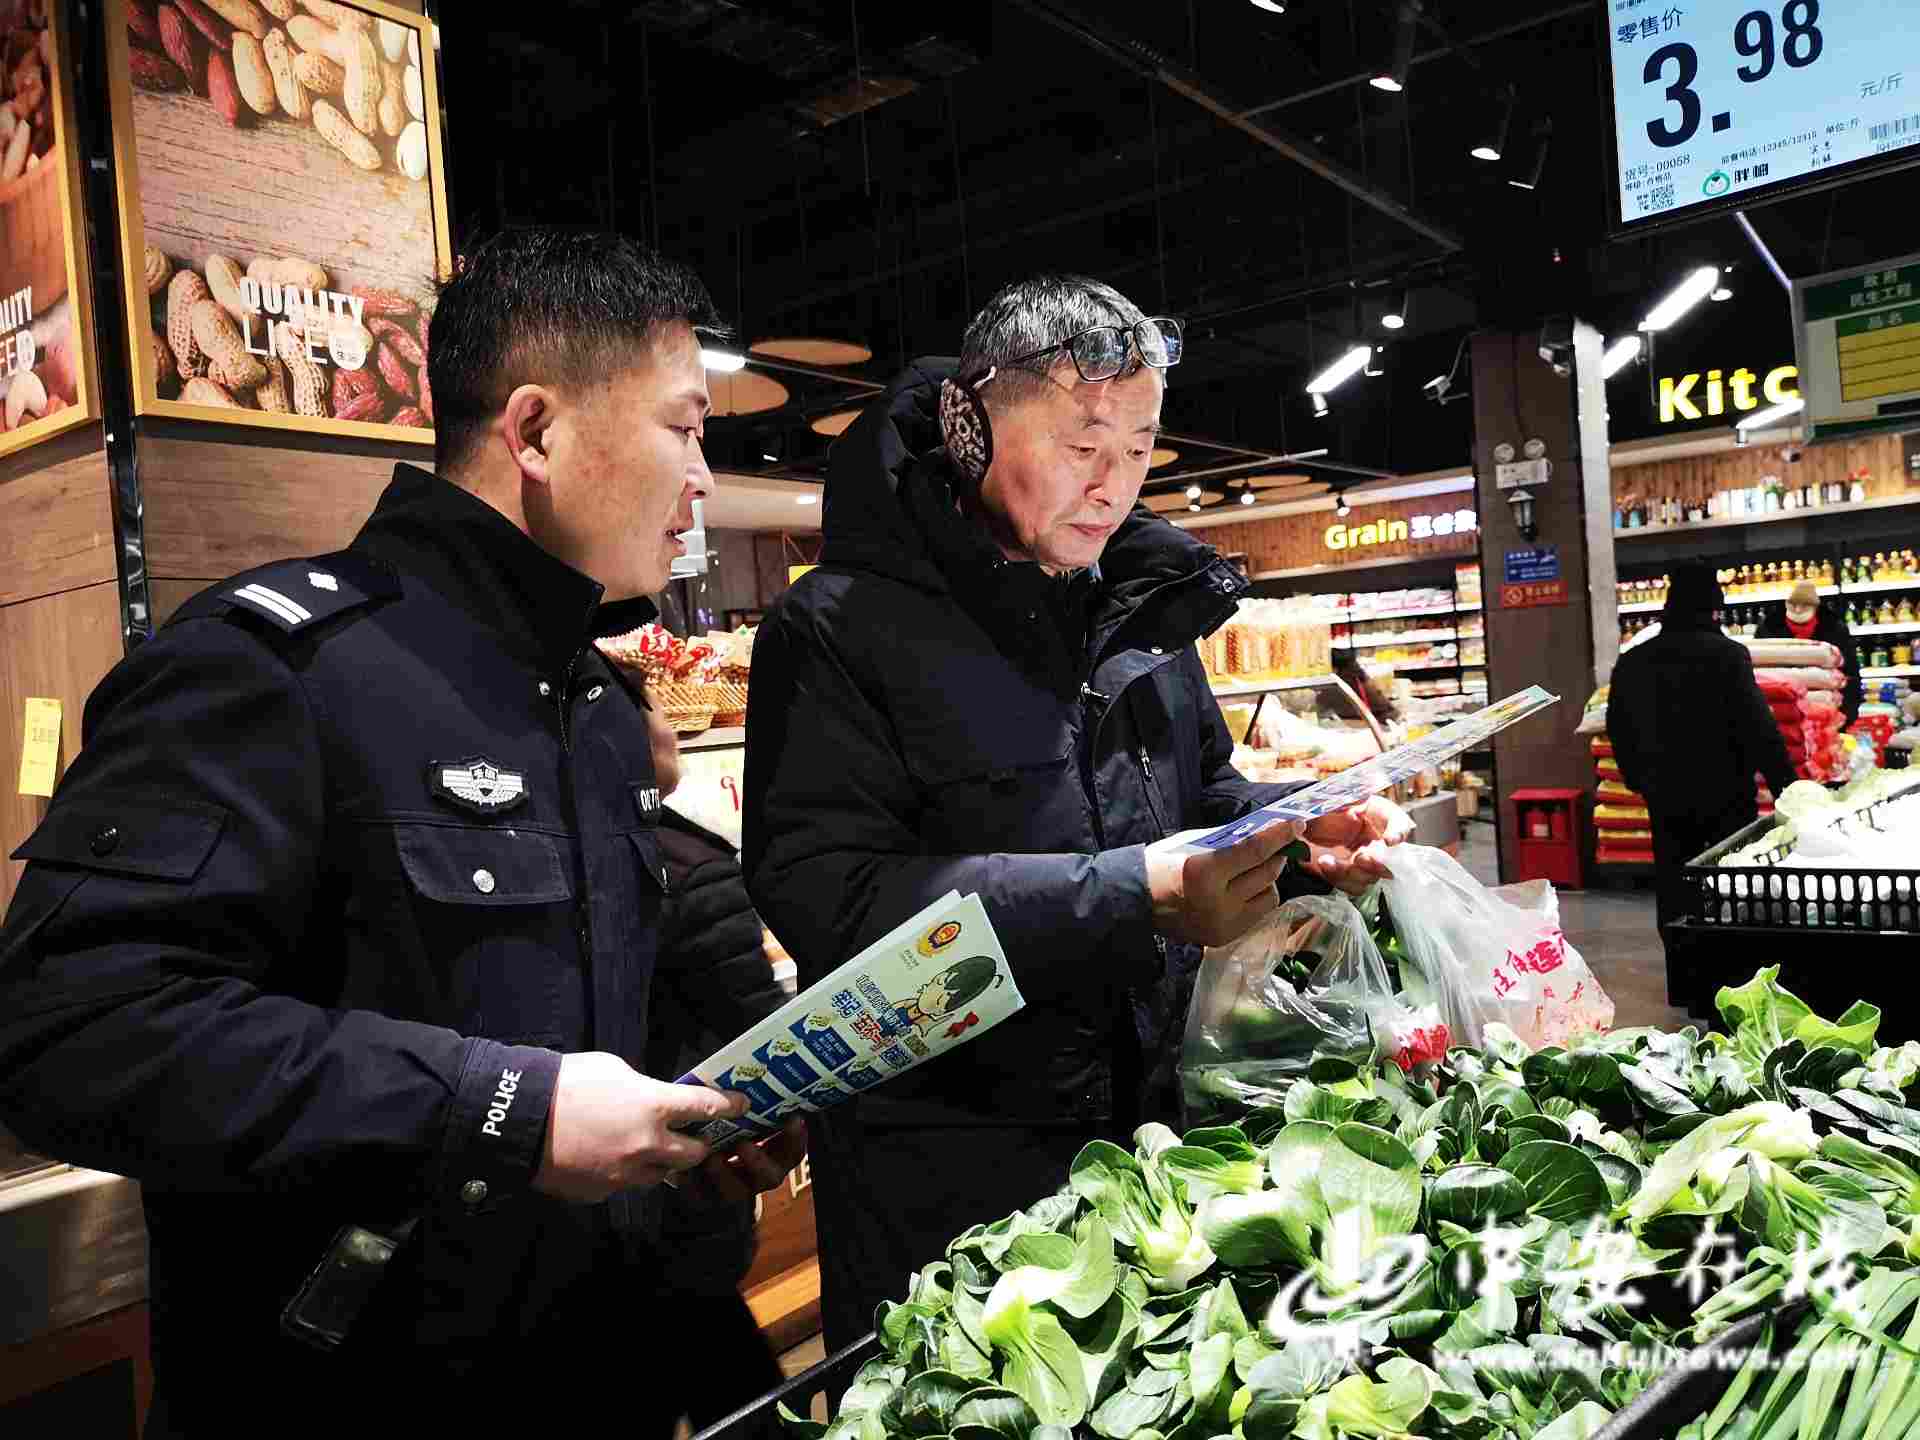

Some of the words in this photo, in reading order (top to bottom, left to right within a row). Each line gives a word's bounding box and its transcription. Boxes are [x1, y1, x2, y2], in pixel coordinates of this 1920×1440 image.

[1617, 8, 1684, 43] 零售价
[1860, 72, 1904, 99] 元/斤
[240, 277, 367, 326] QUALITY
[242, 315, 328, 364] LIE
[1324, 519, 1408, 549] Grain
[482, 1068, 523, 1137] POLICE
